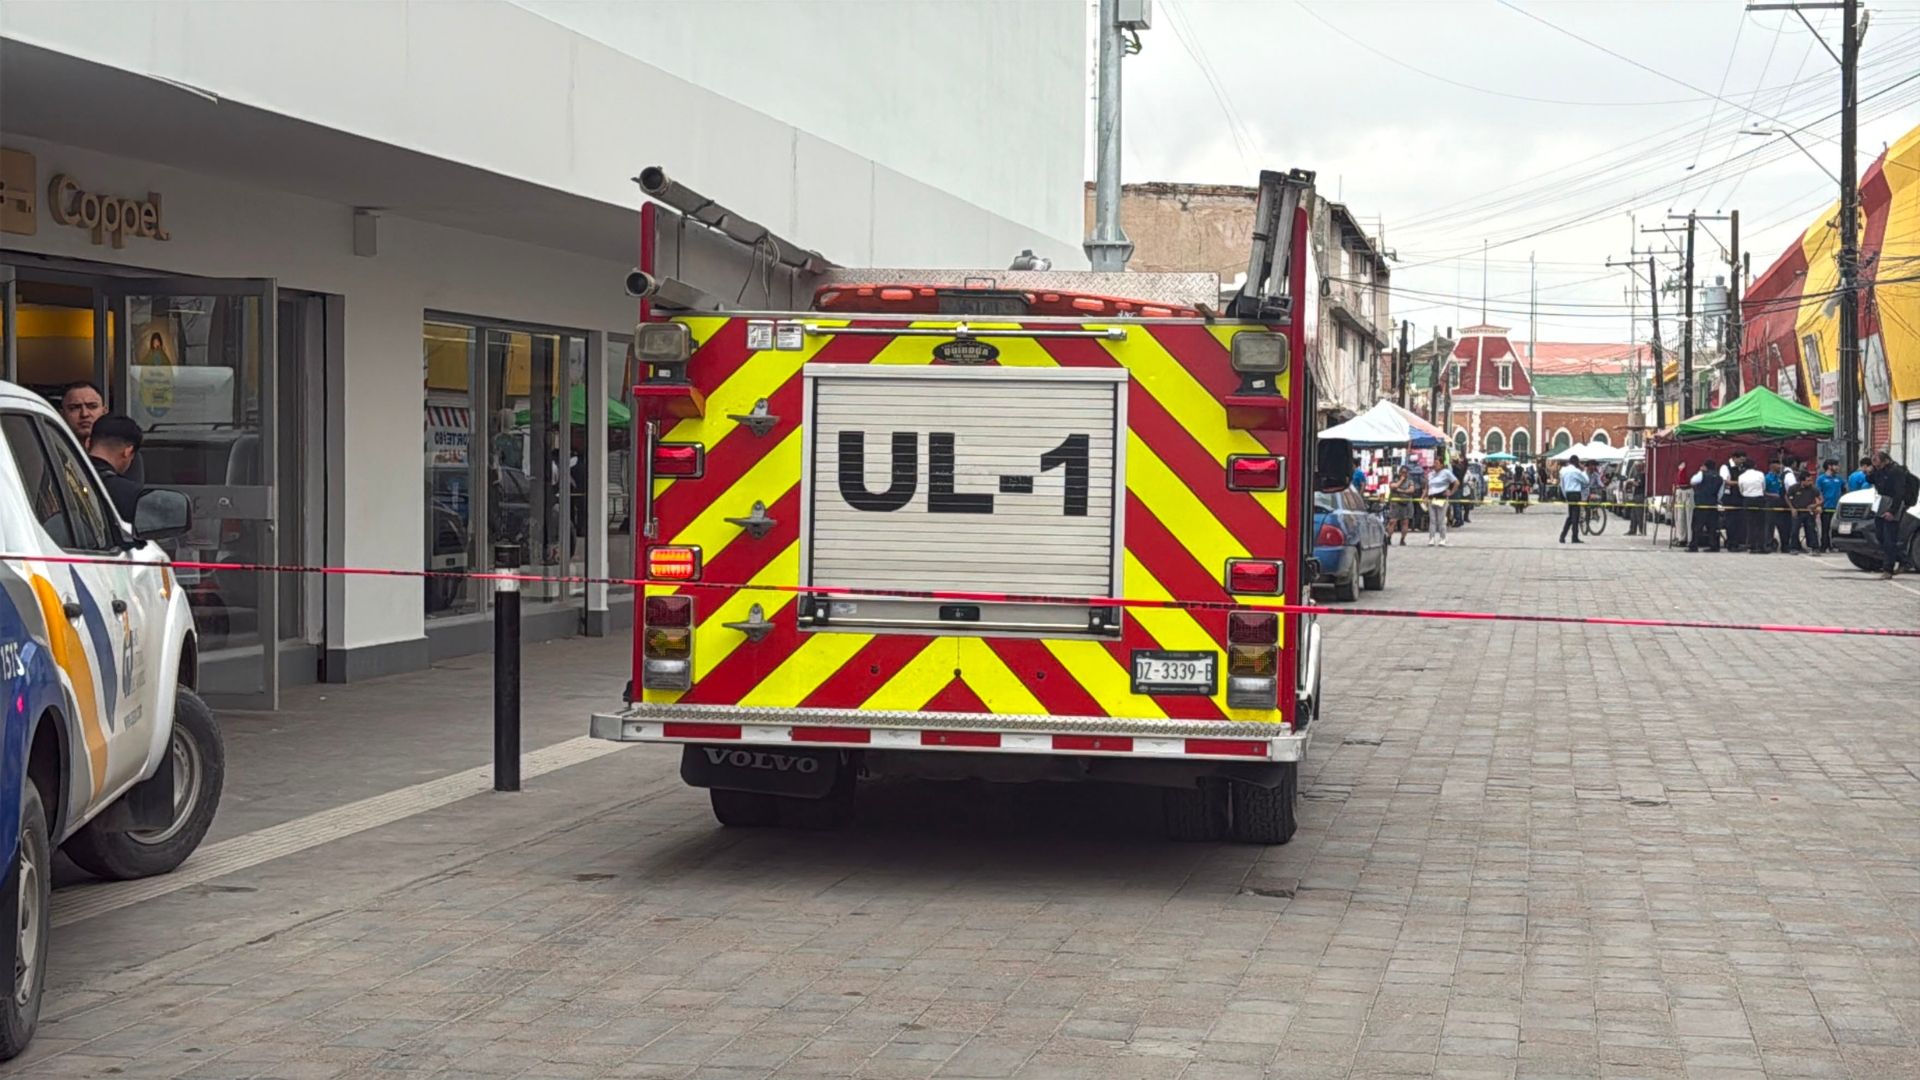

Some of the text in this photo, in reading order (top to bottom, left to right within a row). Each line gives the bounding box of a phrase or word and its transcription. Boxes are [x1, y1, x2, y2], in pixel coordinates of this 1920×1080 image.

[48, 174, 170, 249] Coppel
[838, 431, 1089, 516] UL-1
[703, 747, 819, 773] VOLVO
